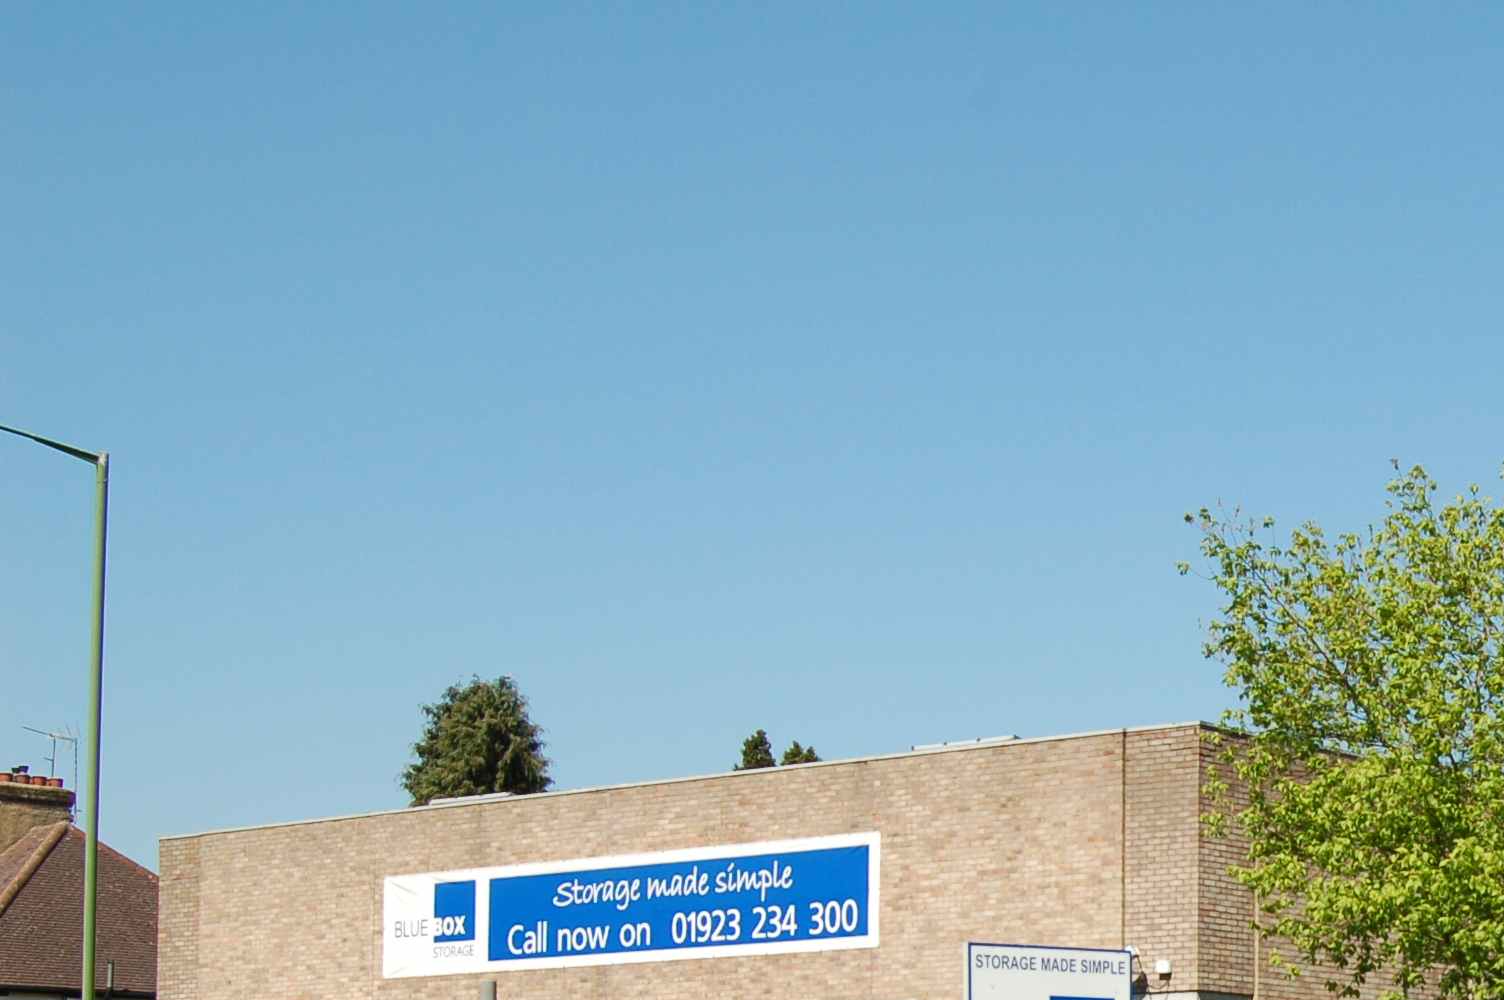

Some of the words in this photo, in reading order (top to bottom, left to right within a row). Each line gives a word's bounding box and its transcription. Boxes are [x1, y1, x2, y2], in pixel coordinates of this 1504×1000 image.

[552, 876, 641, 911] Storage
[647, 865, 709, 900] made
[714, 860, 793, 901] simple
[394, 919, 429, 938] BLUE
[433, 915, 466, 937] BOX
[507, 923, 547, 957] Call
[557, 924, 610, 952] now
[619, 919, 652, 948] on
[671, 908, 742, 944] 01923
[751, 904, 798, 940] 234
[808, 899, 859, 936] 300
[432, 944, 475, 959] STORAGE
[975, 953, 1037, 971] STORAGE
[1040, 957, 1077, 973] MADE
[1081, 959, 1126, 975] SIMPLE
